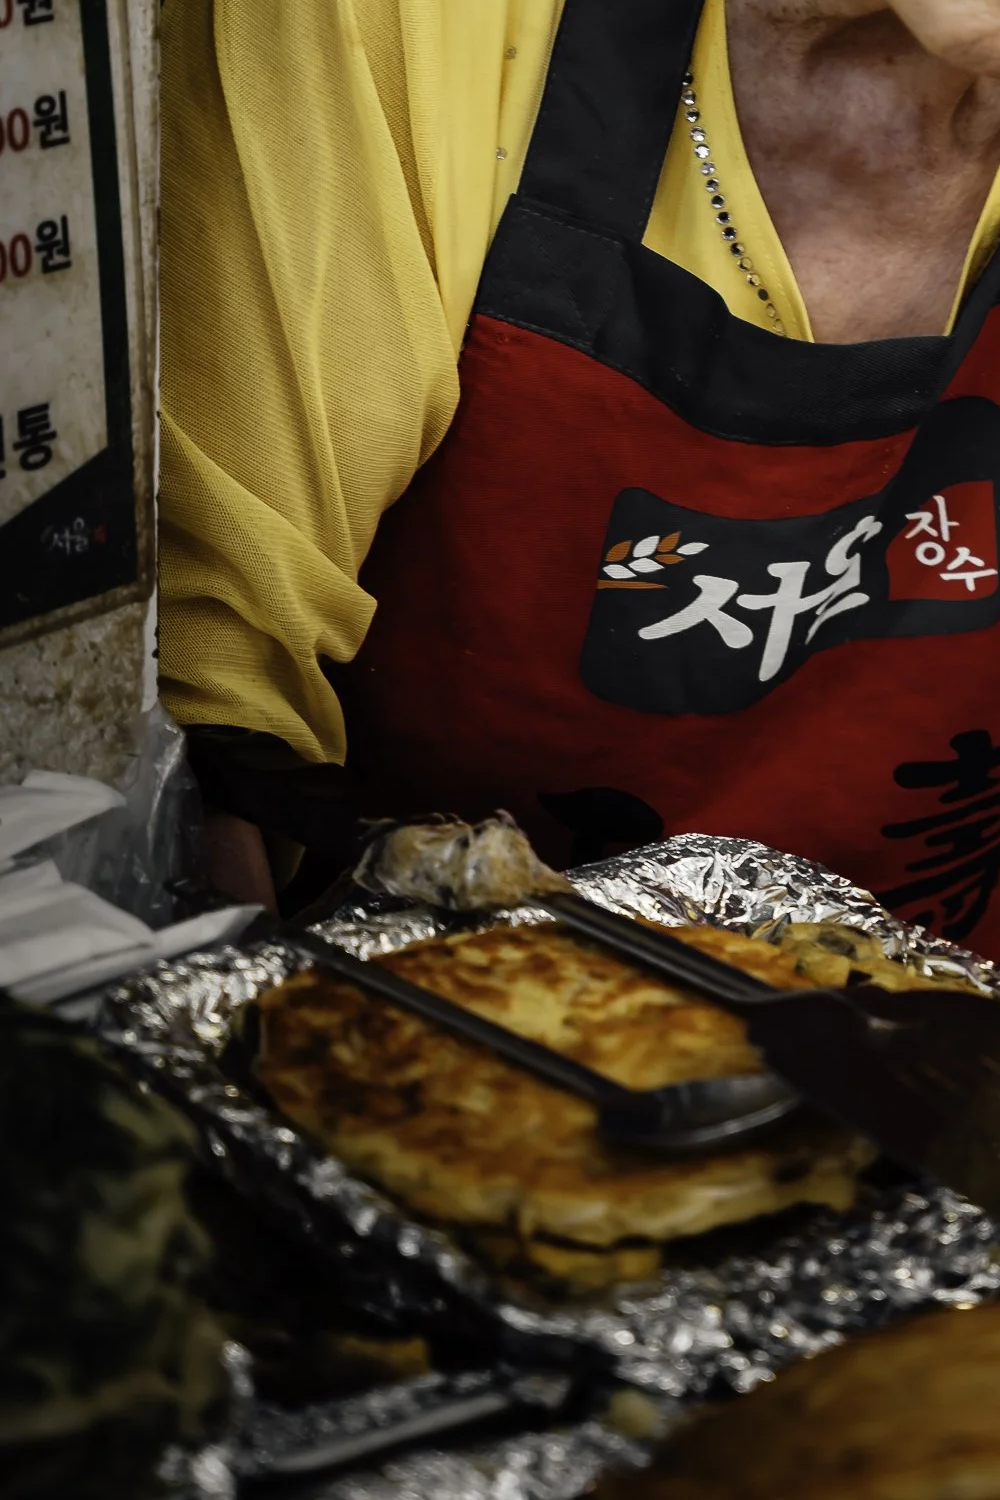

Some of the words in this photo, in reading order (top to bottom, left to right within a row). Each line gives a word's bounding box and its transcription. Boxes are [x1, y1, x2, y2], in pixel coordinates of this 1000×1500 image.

[0, 88, 70, 155] 0원
[0, 214, 72, 283] 0원
[0, 402, 57, 479] 통
[904, 495, 998, 592] 장수
